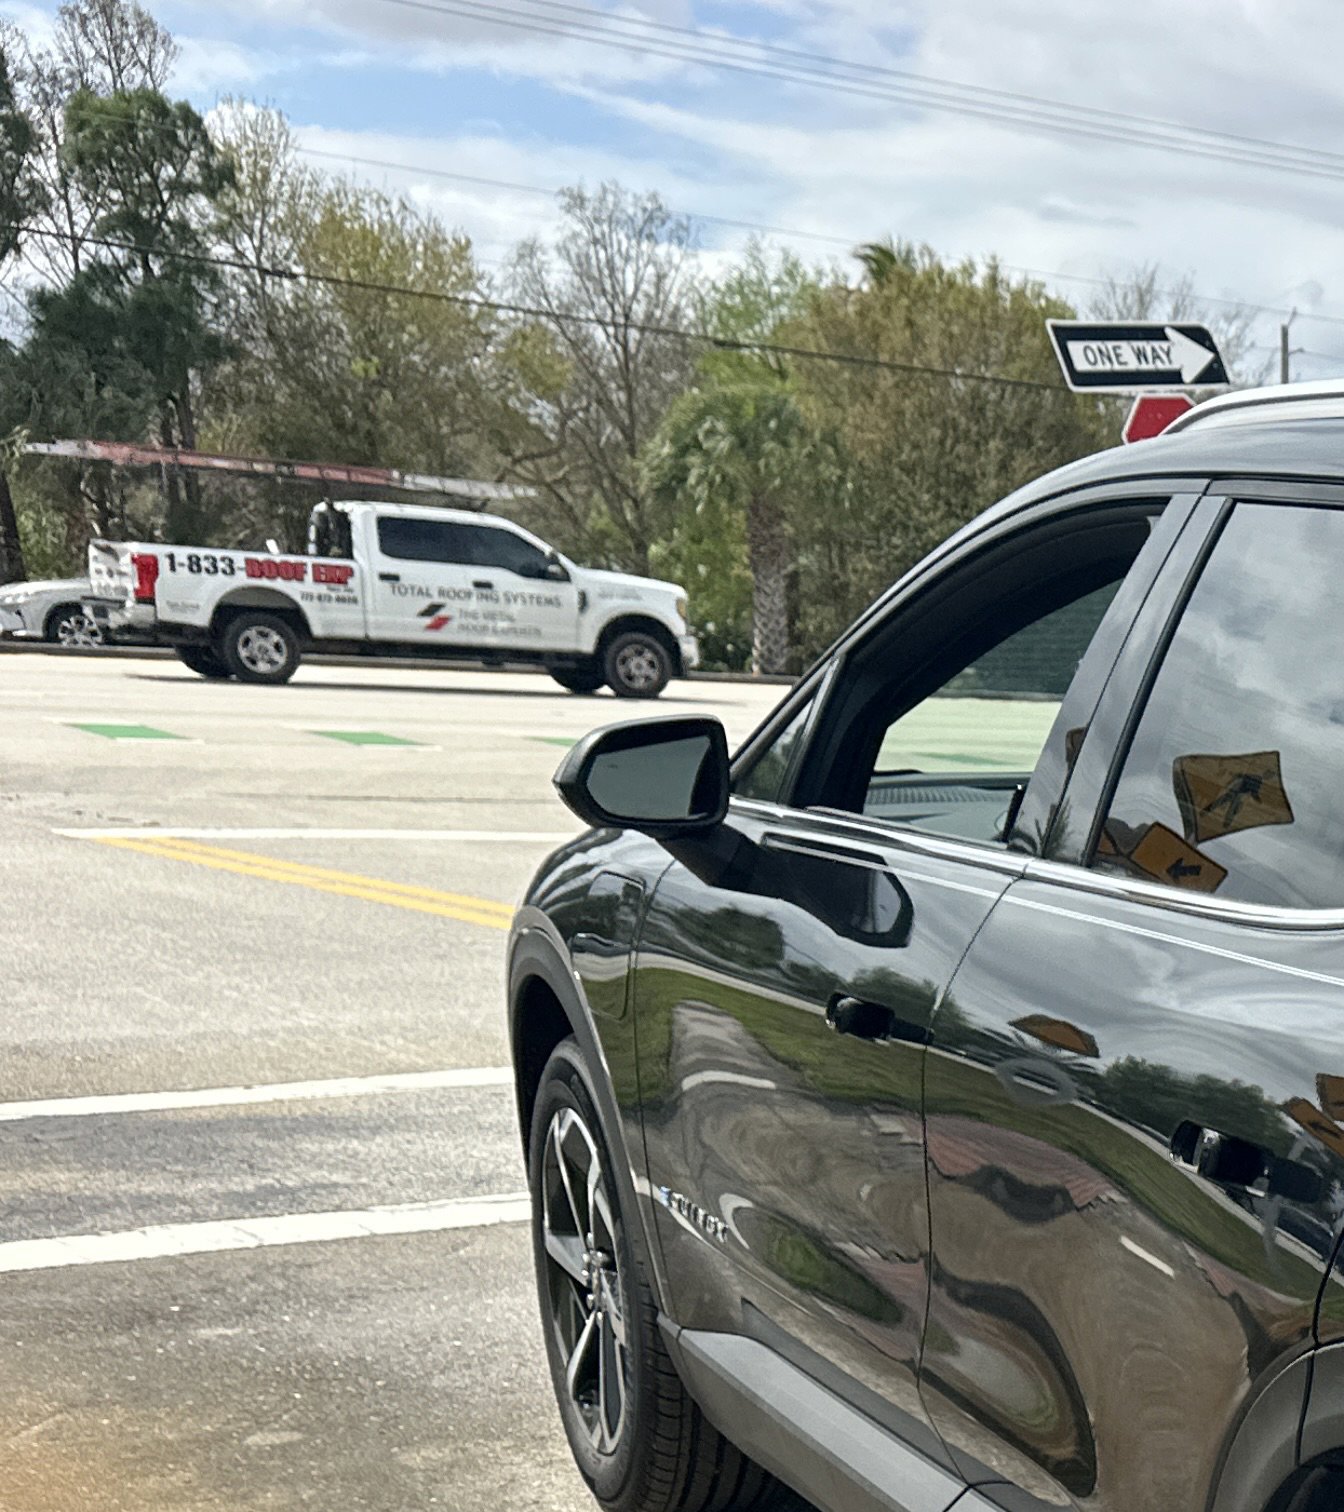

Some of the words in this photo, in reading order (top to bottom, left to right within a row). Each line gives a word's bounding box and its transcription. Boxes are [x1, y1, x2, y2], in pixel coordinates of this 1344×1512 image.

[1083, 344, 1128, 367] ONE
[1131, 344, 1173, 367] WAY
[390, 583, 432, 599] TOTAL
[437, 588, 499, 603] ROOFING
[503, 591, 562, 608] SYSTEMS
